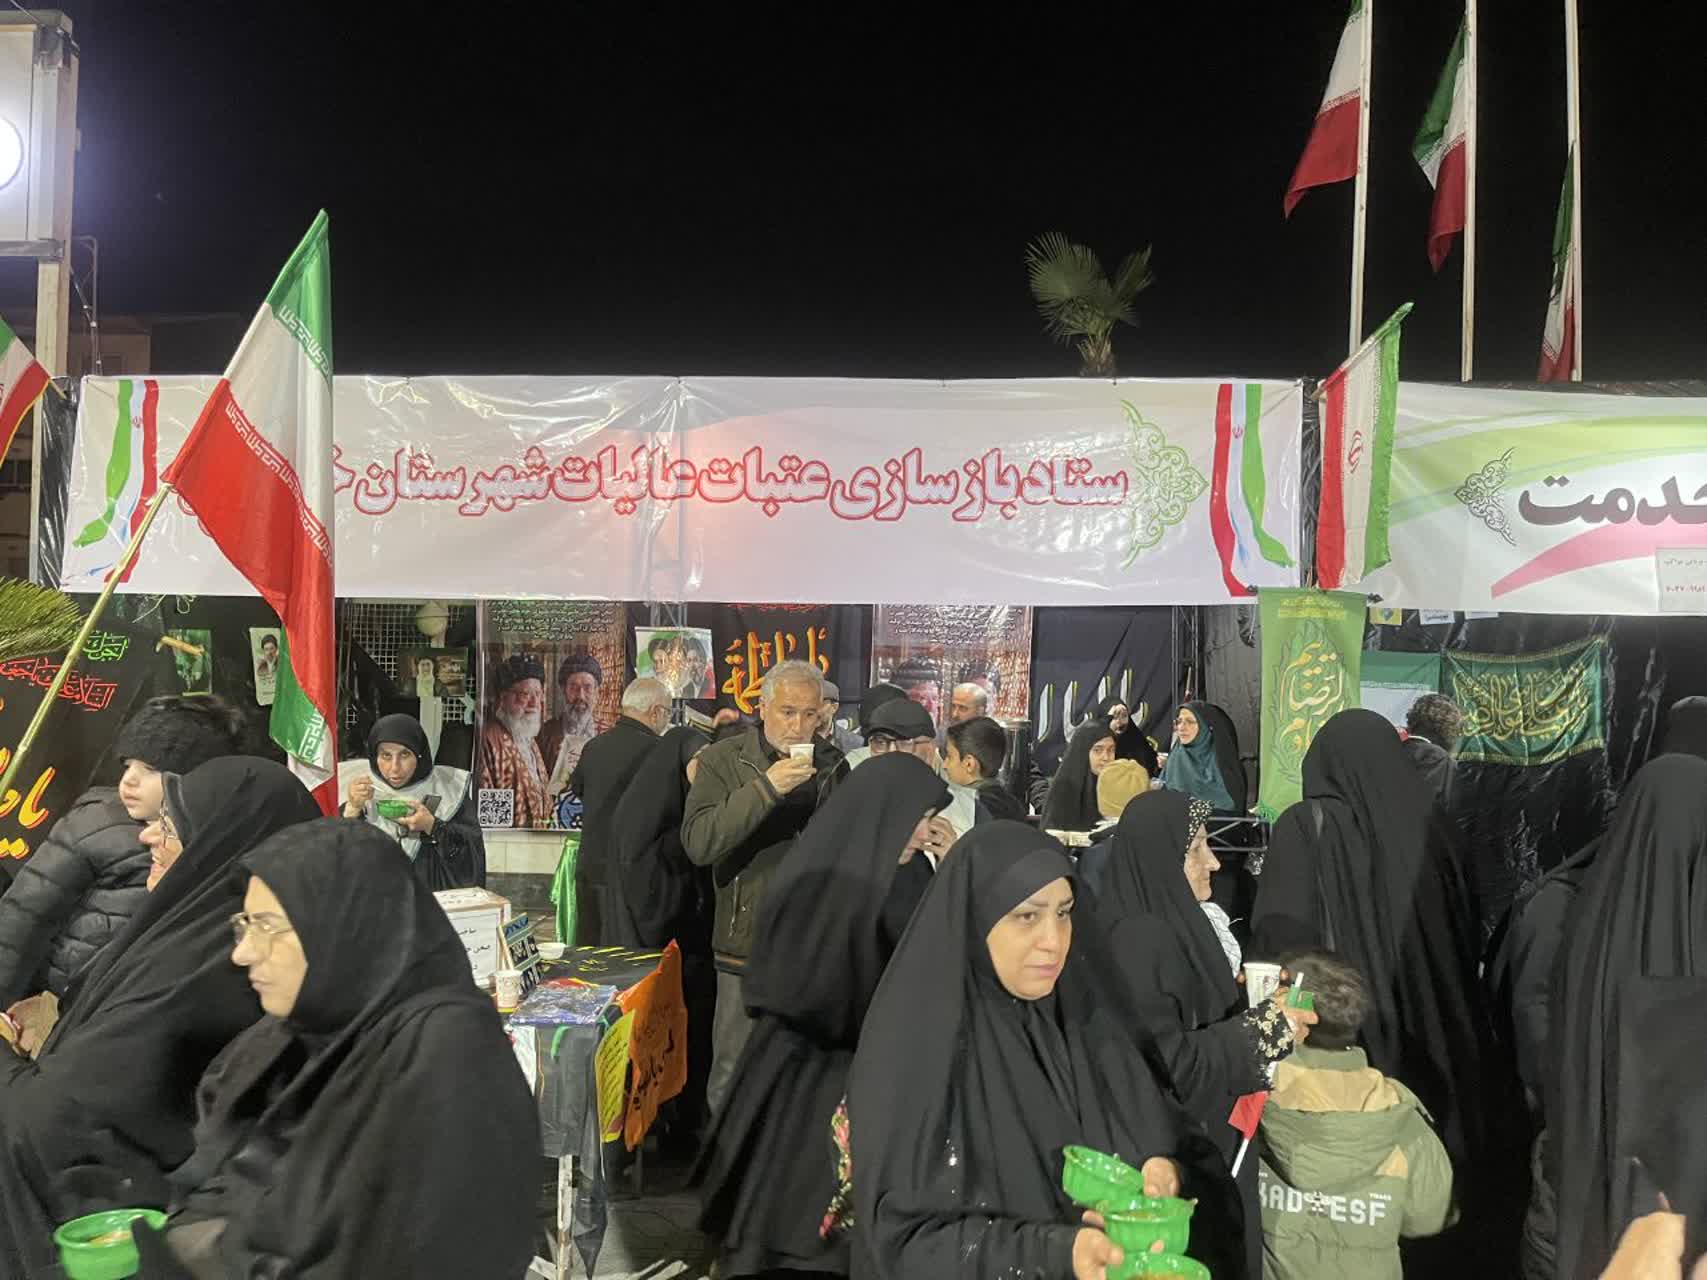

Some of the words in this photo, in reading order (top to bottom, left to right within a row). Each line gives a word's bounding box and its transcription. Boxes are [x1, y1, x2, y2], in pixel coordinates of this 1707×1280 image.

[353, 445, 552, 517] شهرستان
[551, 443, 698, 516] عالیات
[696, 446, 831, 518] عتبات
[1018, 456, 1128, 506] ستاد
